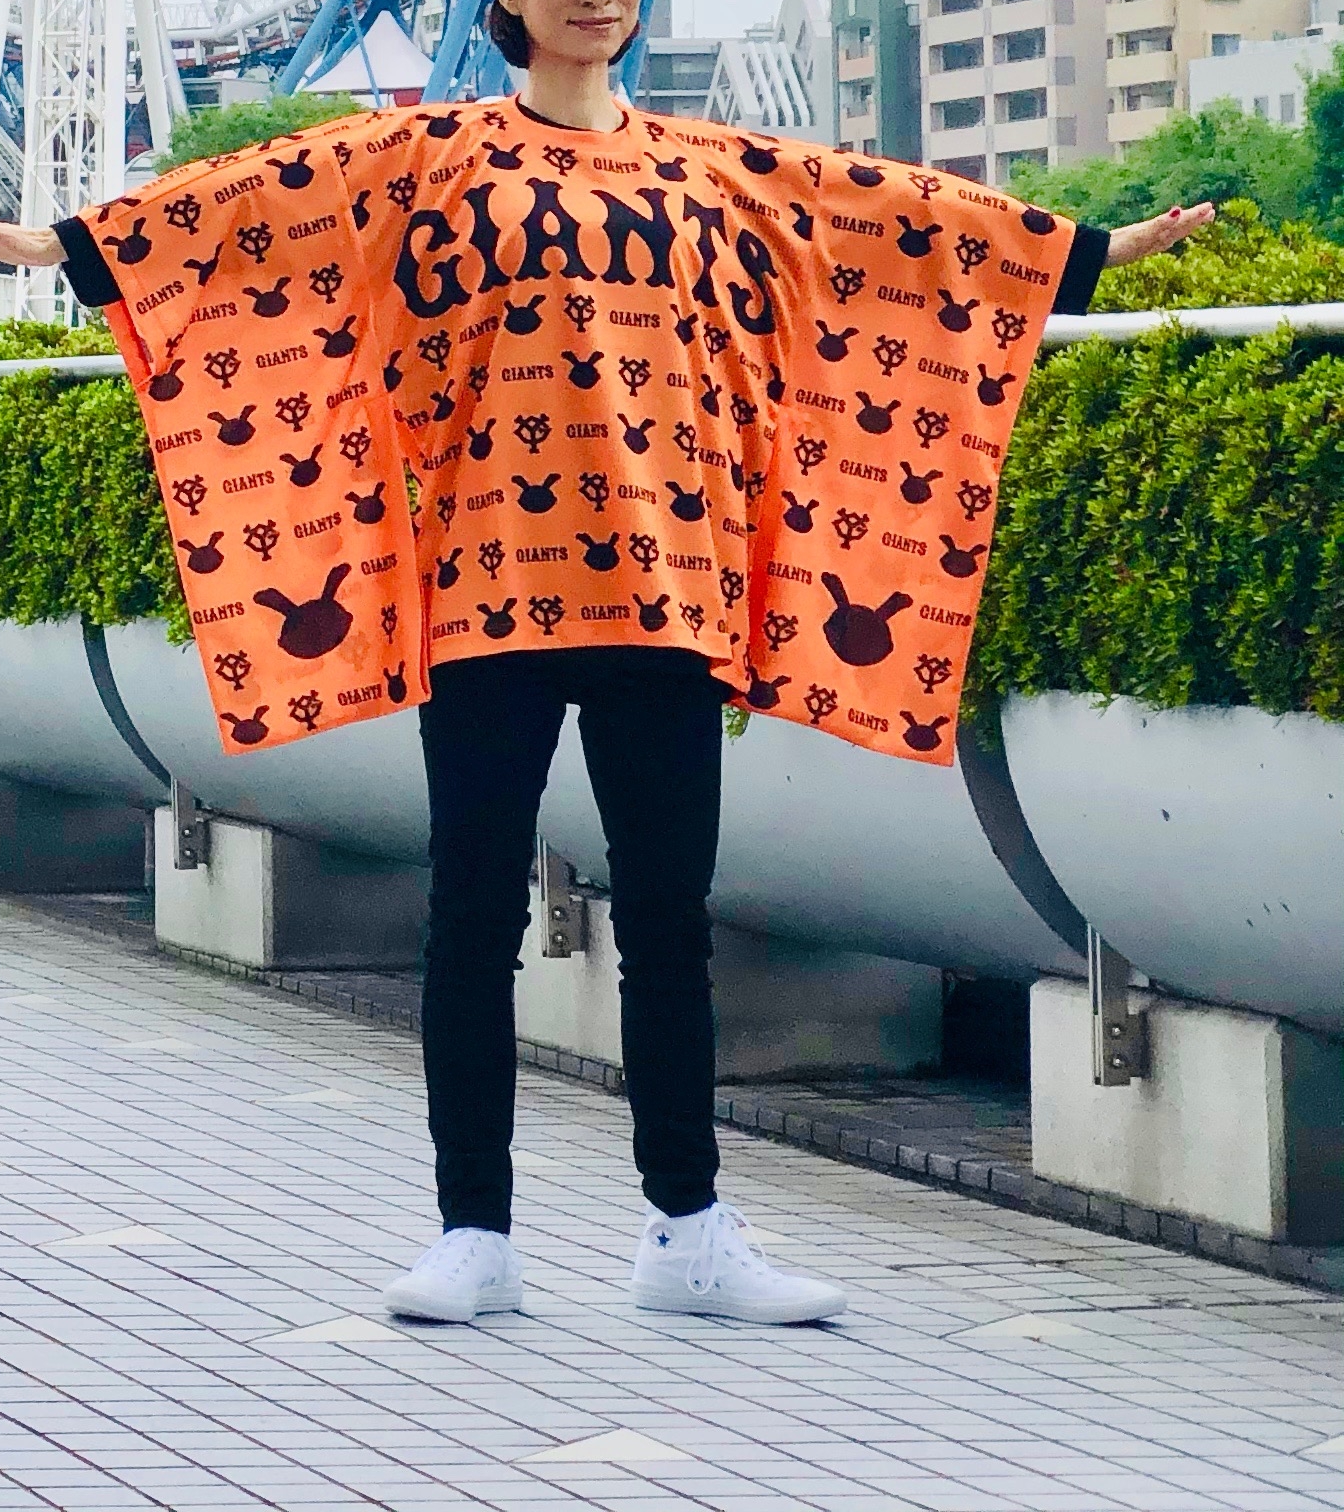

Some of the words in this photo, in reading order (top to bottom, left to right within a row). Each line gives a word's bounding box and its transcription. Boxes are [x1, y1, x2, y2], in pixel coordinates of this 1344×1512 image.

[367, 128, 412, 153] GIANTS
[594, 158, 641, 173] GIANTS
[215, 175, 264, 204] GIANTS
[959, 190, 1007, 211] GIANTS
[288, 215, 337, 239] GIANTS
[831, 215, 885, 237] GIANTS
[393, 178, 778, 335] GIANTS
[1000, 260, 1049, 285] GIANTS
[136, 281, 184, 314] GIANTS
[878, 286, 925, 308] GIANTS
[610, 310, 660, 328] GIANTS
[256, 345, 308, 368] GIANTS
[502, 365, 554, 381] GIANTS
[918, 358, 969, 384] GIANTS
[796, 389, 846, 413] GIANTS
[155, 429, 203, 454] GIANTS
[566, 424, 608, 438] GIANTS
[223, 471, 274, 493] GIANTS
[840, 460, 887, 482] GIANTS
[294, 512, 341, 538] GIANTS
[516, 547, 568, 562] GIANTS
[882, 532, 927, 555] GIANTS
[666, 553, 711, 571] GIANTS
[767, 561, 811, 584] GIANTS
[193, 602, 245, 625] GIANTS
[581, 605, 630, 620] GIANTS
[920, 605, 971, 626] GIANTS
[848, 708, 888, 732] GIANTS
